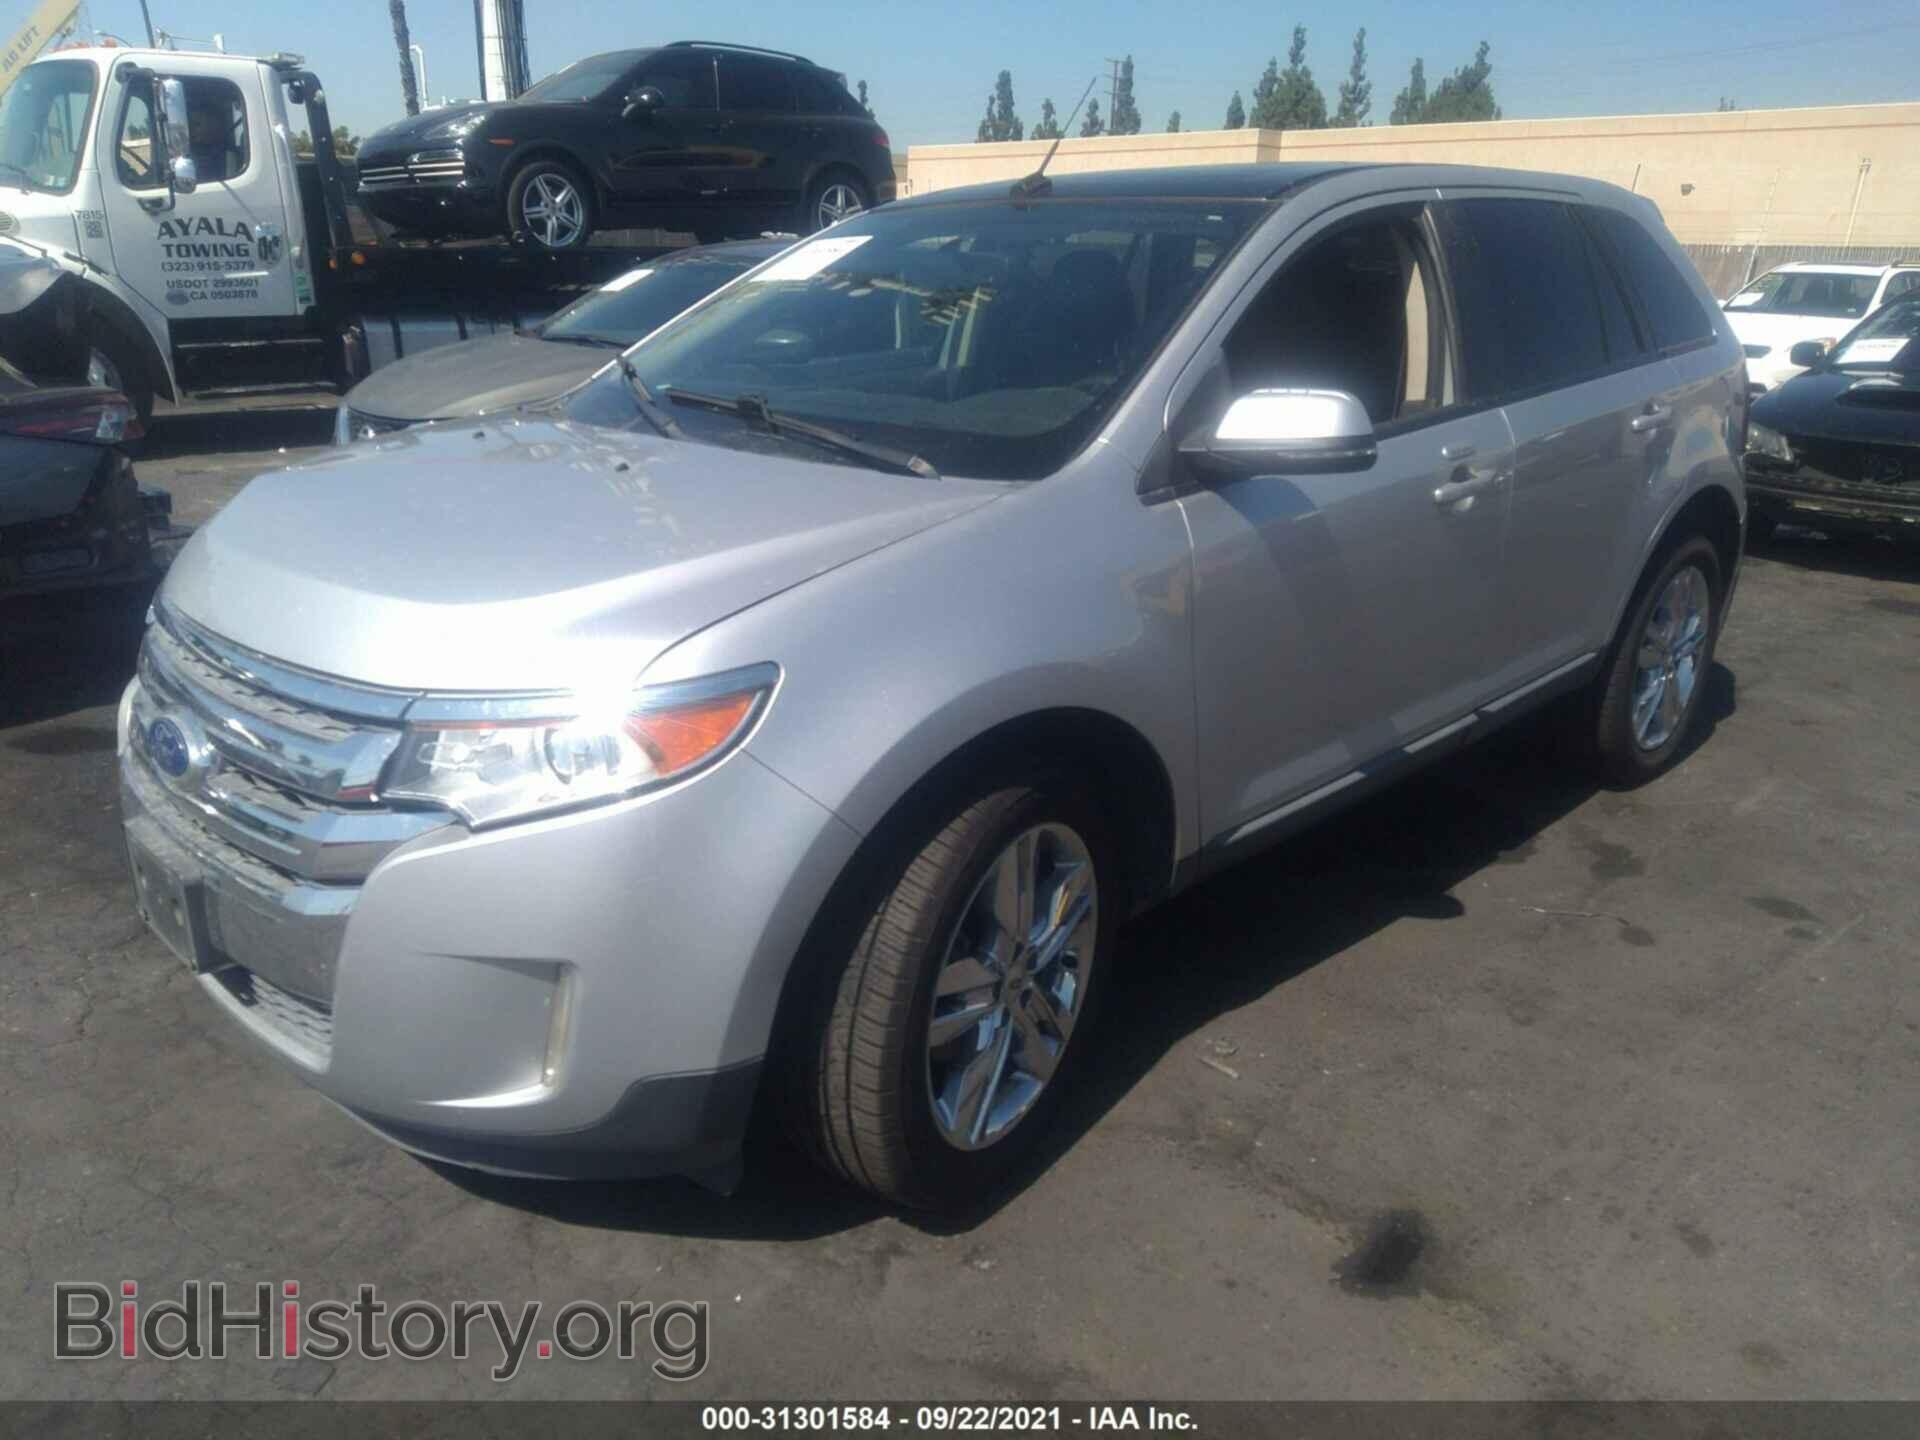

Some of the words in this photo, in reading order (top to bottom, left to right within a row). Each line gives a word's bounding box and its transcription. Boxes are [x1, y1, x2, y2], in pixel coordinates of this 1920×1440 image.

[157, 216, 254, 243] AYALA
[162, 243, 249, 258] TOWING
[166, 279, 208, 289] USDOT
[190, 290, 208, 300] CA
